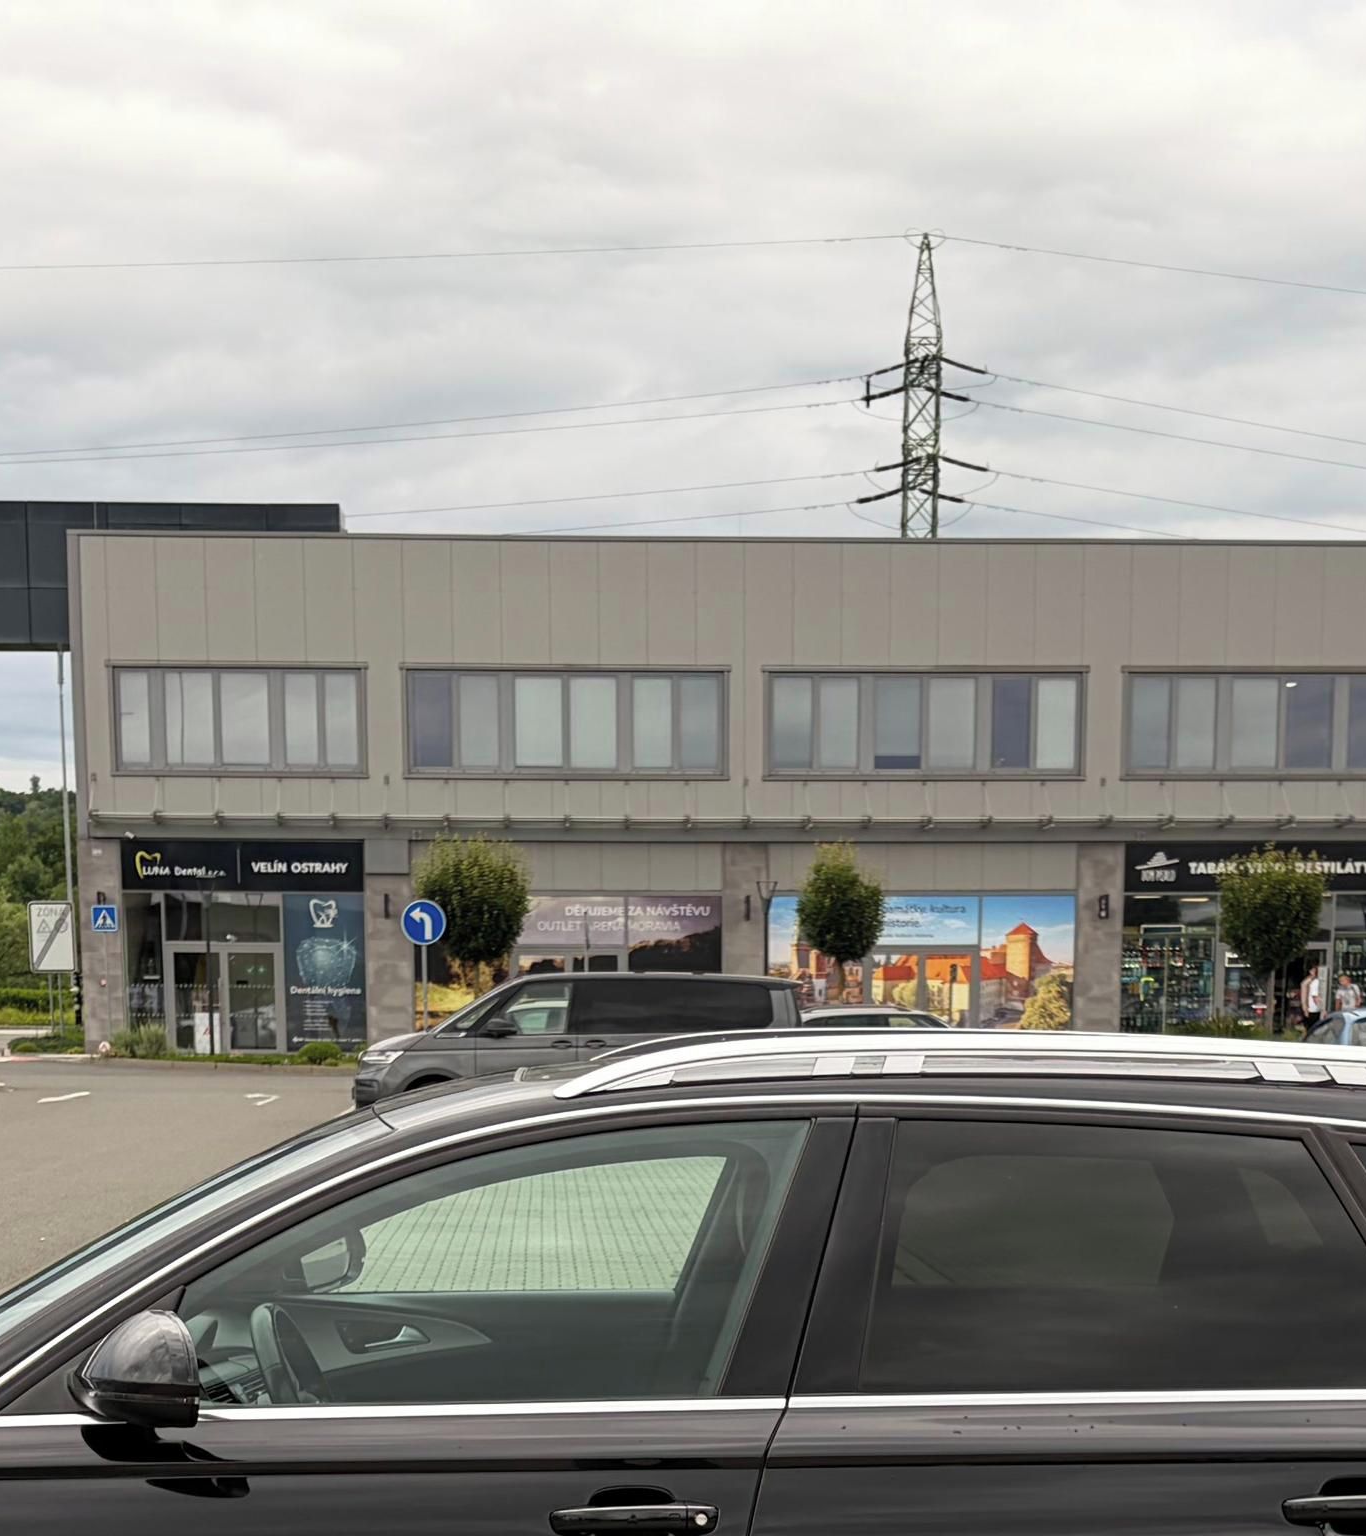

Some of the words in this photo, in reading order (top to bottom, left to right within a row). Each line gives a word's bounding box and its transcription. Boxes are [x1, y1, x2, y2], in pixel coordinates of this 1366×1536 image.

[252, 859, 287, 873] VELÍN
[291, 861, 348, 874] OSTRAHY
[627, 906, 644, 917] ZA
[646, 904, 711, 917] NÁVŠTĚVU
[537, 920, 583, 931] OUTLET
